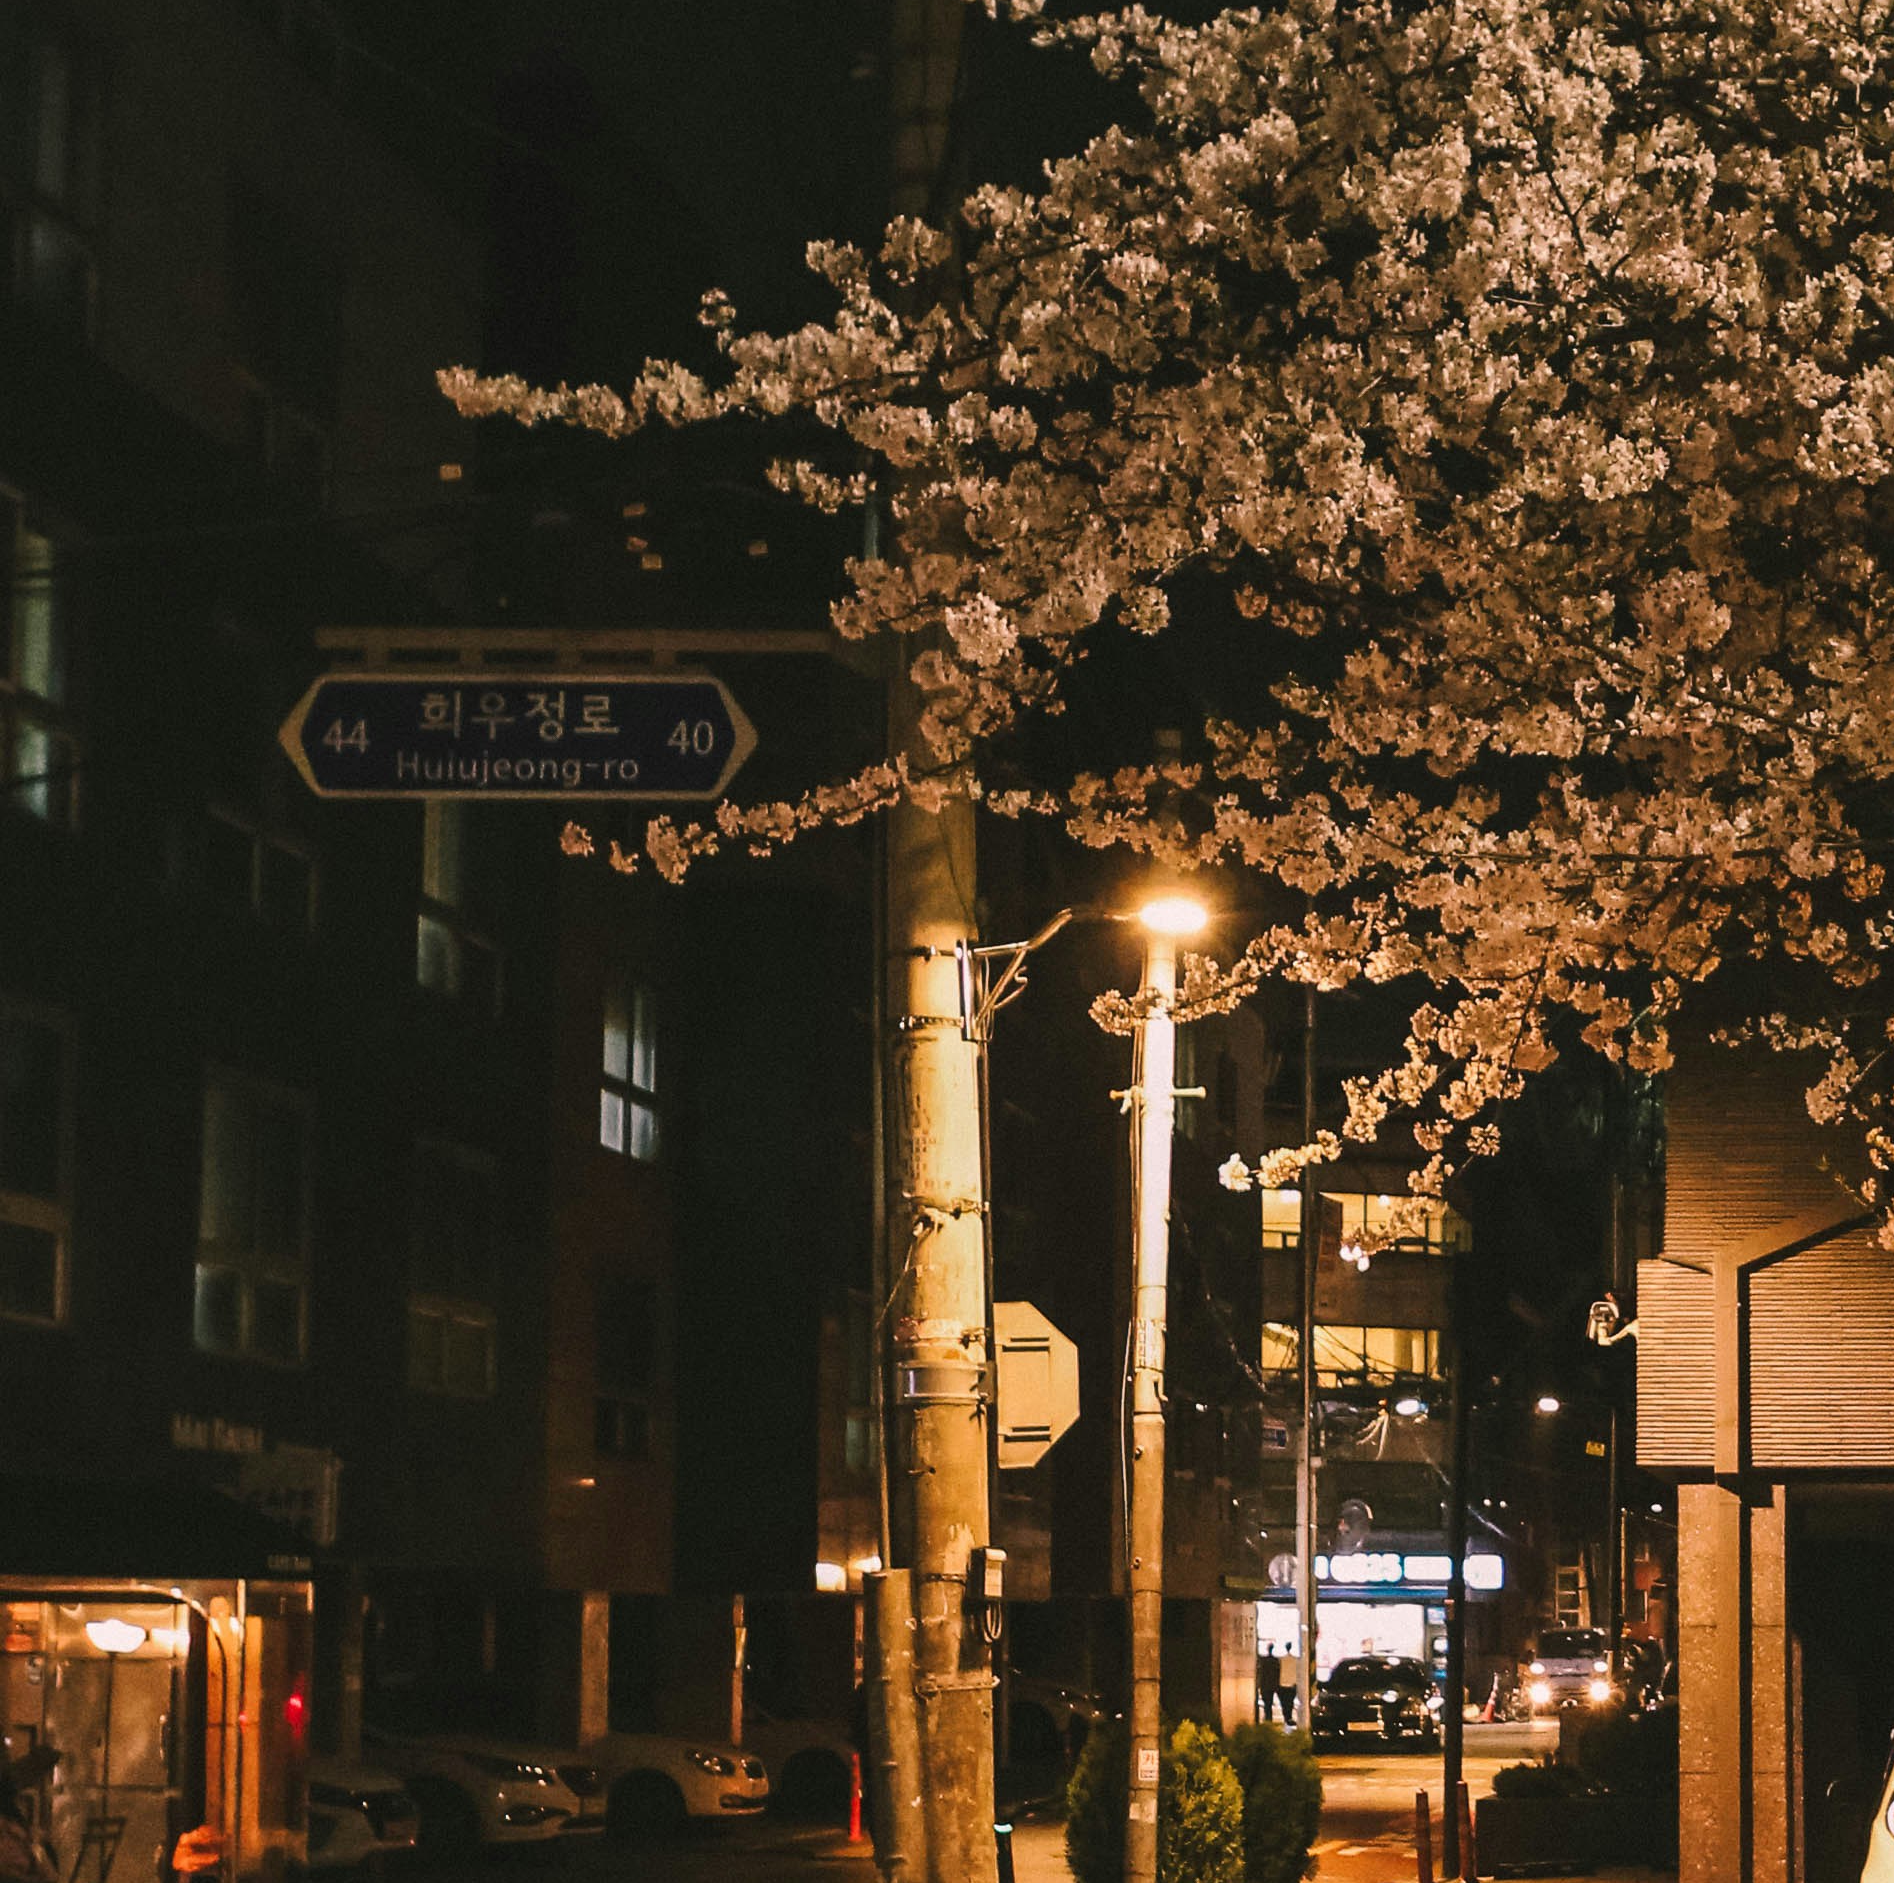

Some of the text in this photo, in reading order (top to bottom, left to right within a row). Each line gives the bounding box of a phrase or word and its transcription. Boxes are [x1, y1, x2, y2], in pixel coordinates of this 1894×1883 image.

[420, 691, 620, 742] 희우정로
[323, 719, 369, 753] 44
[667, 719, 714, 755] 40
[398, 749, 639, 788] Huiujeong-ro
